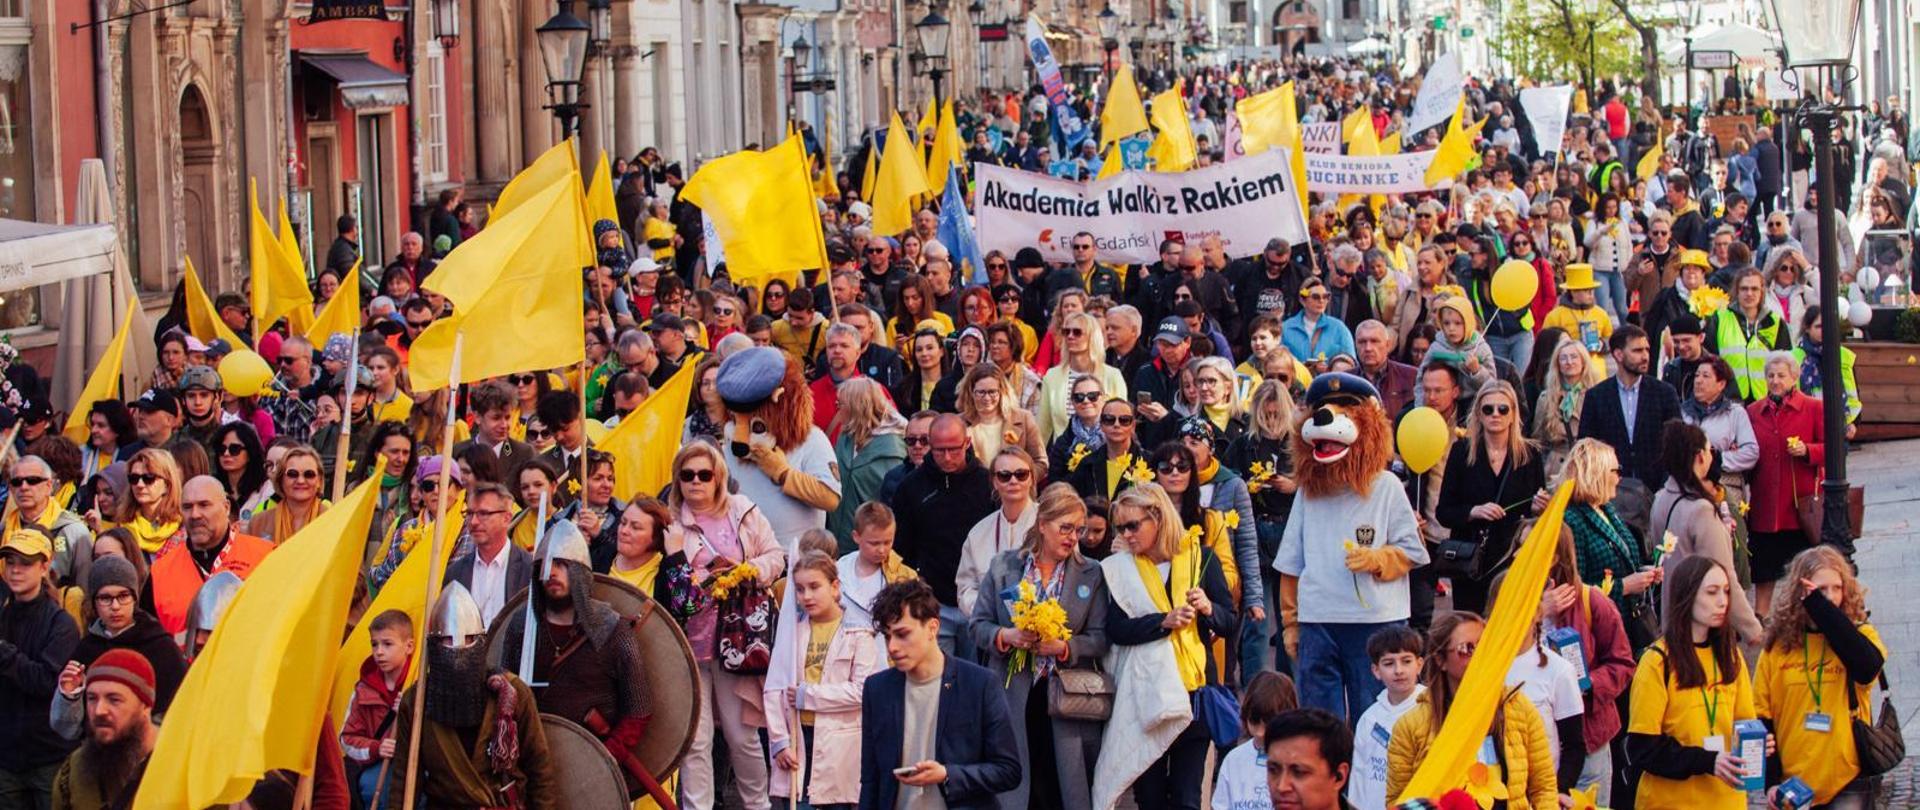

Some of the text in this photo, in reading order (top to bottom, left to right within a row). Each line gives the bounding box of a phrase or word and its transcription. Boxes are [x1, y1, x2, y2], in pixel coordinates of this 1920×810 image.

[316, 4, 379, 18] AMBER
[1309, 160, 1392, 170] KLUB SENIORA
[983, 172, 1285, 217] Akademia Walki z Rakiem
